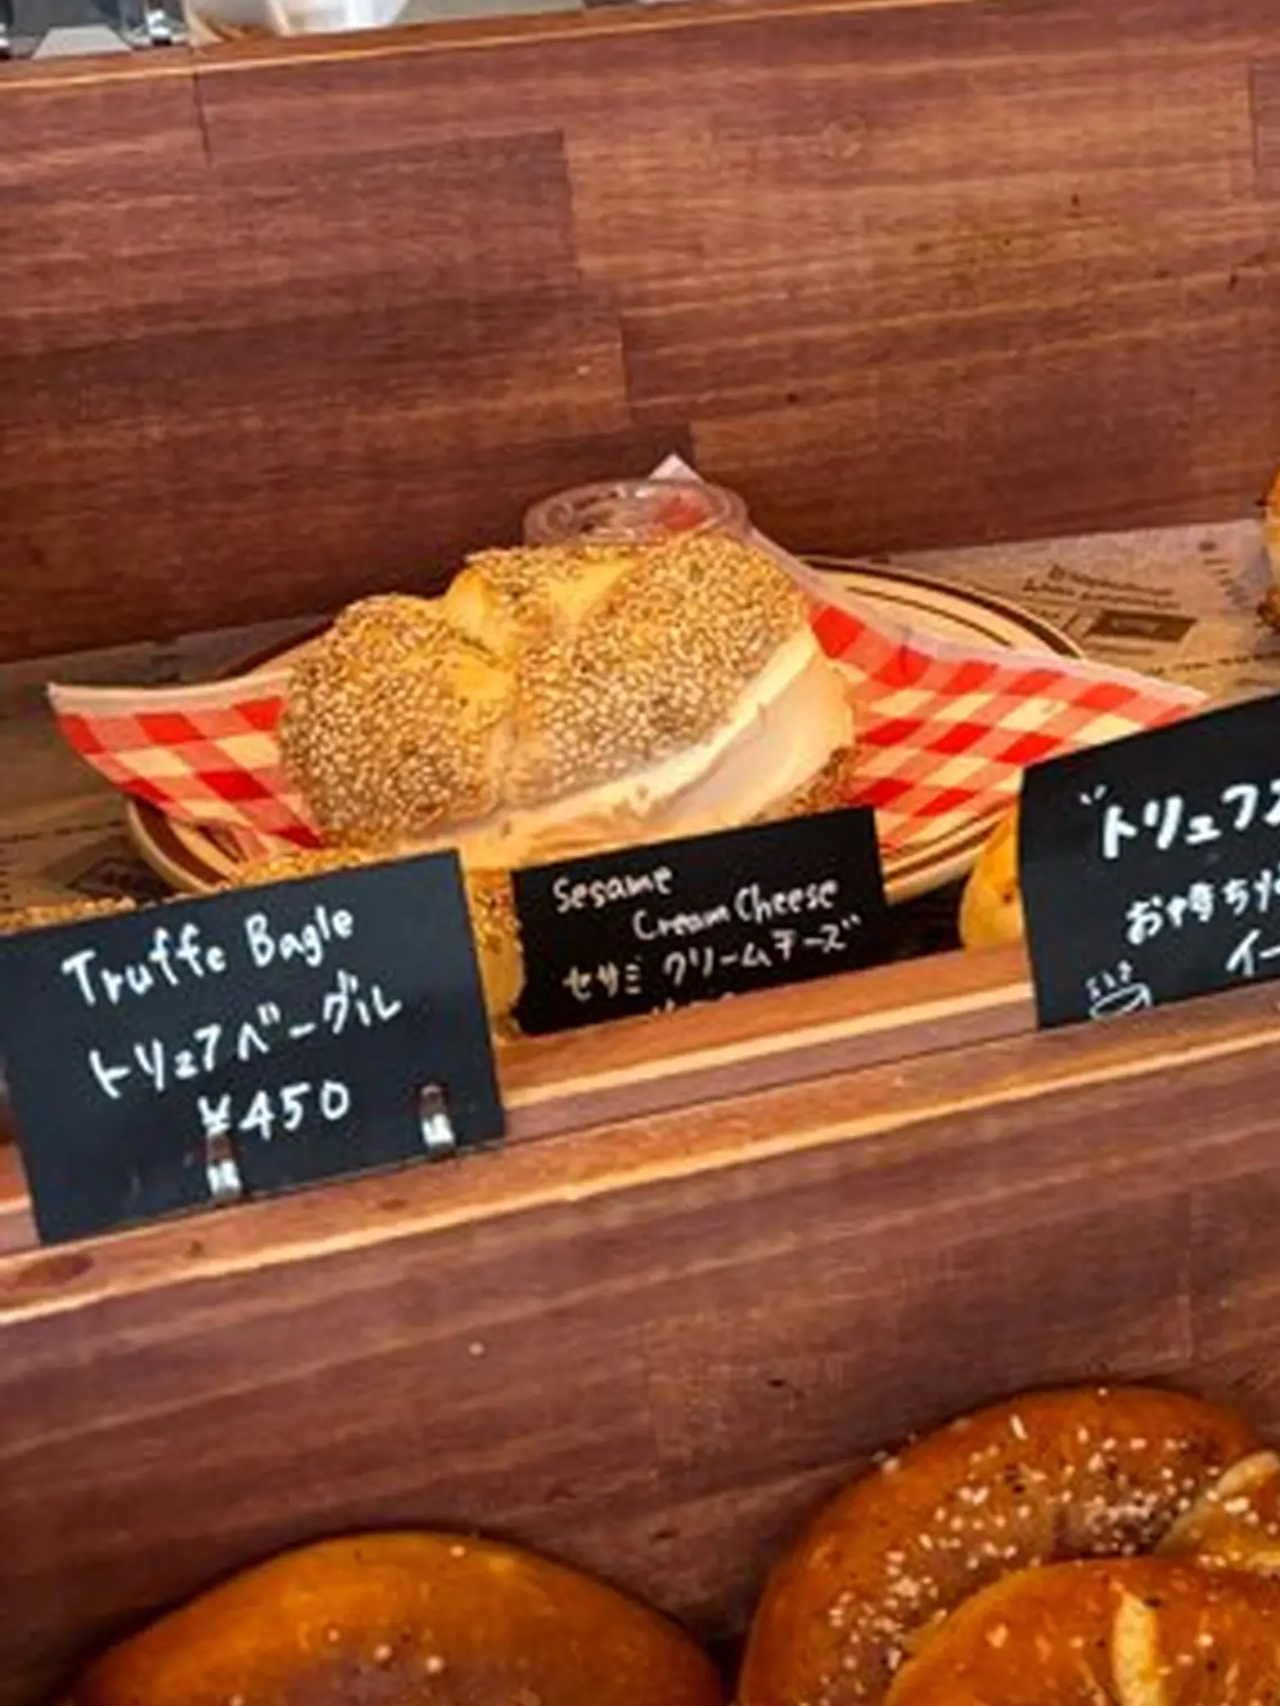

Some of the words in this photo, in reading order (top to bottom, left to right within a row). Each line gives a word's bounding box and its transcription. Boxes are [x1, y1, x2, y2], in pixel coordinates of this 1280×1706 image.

[551, 865, 674, 915] Sesame
[632, 903, 731, 941] Cream
[733, 878, 840, 925] Cheese
[60, 922, 227, 1007] Truffe
[243, 903, 356, 969] Bagle
[198, 1079, 352, 1141] ¥450
